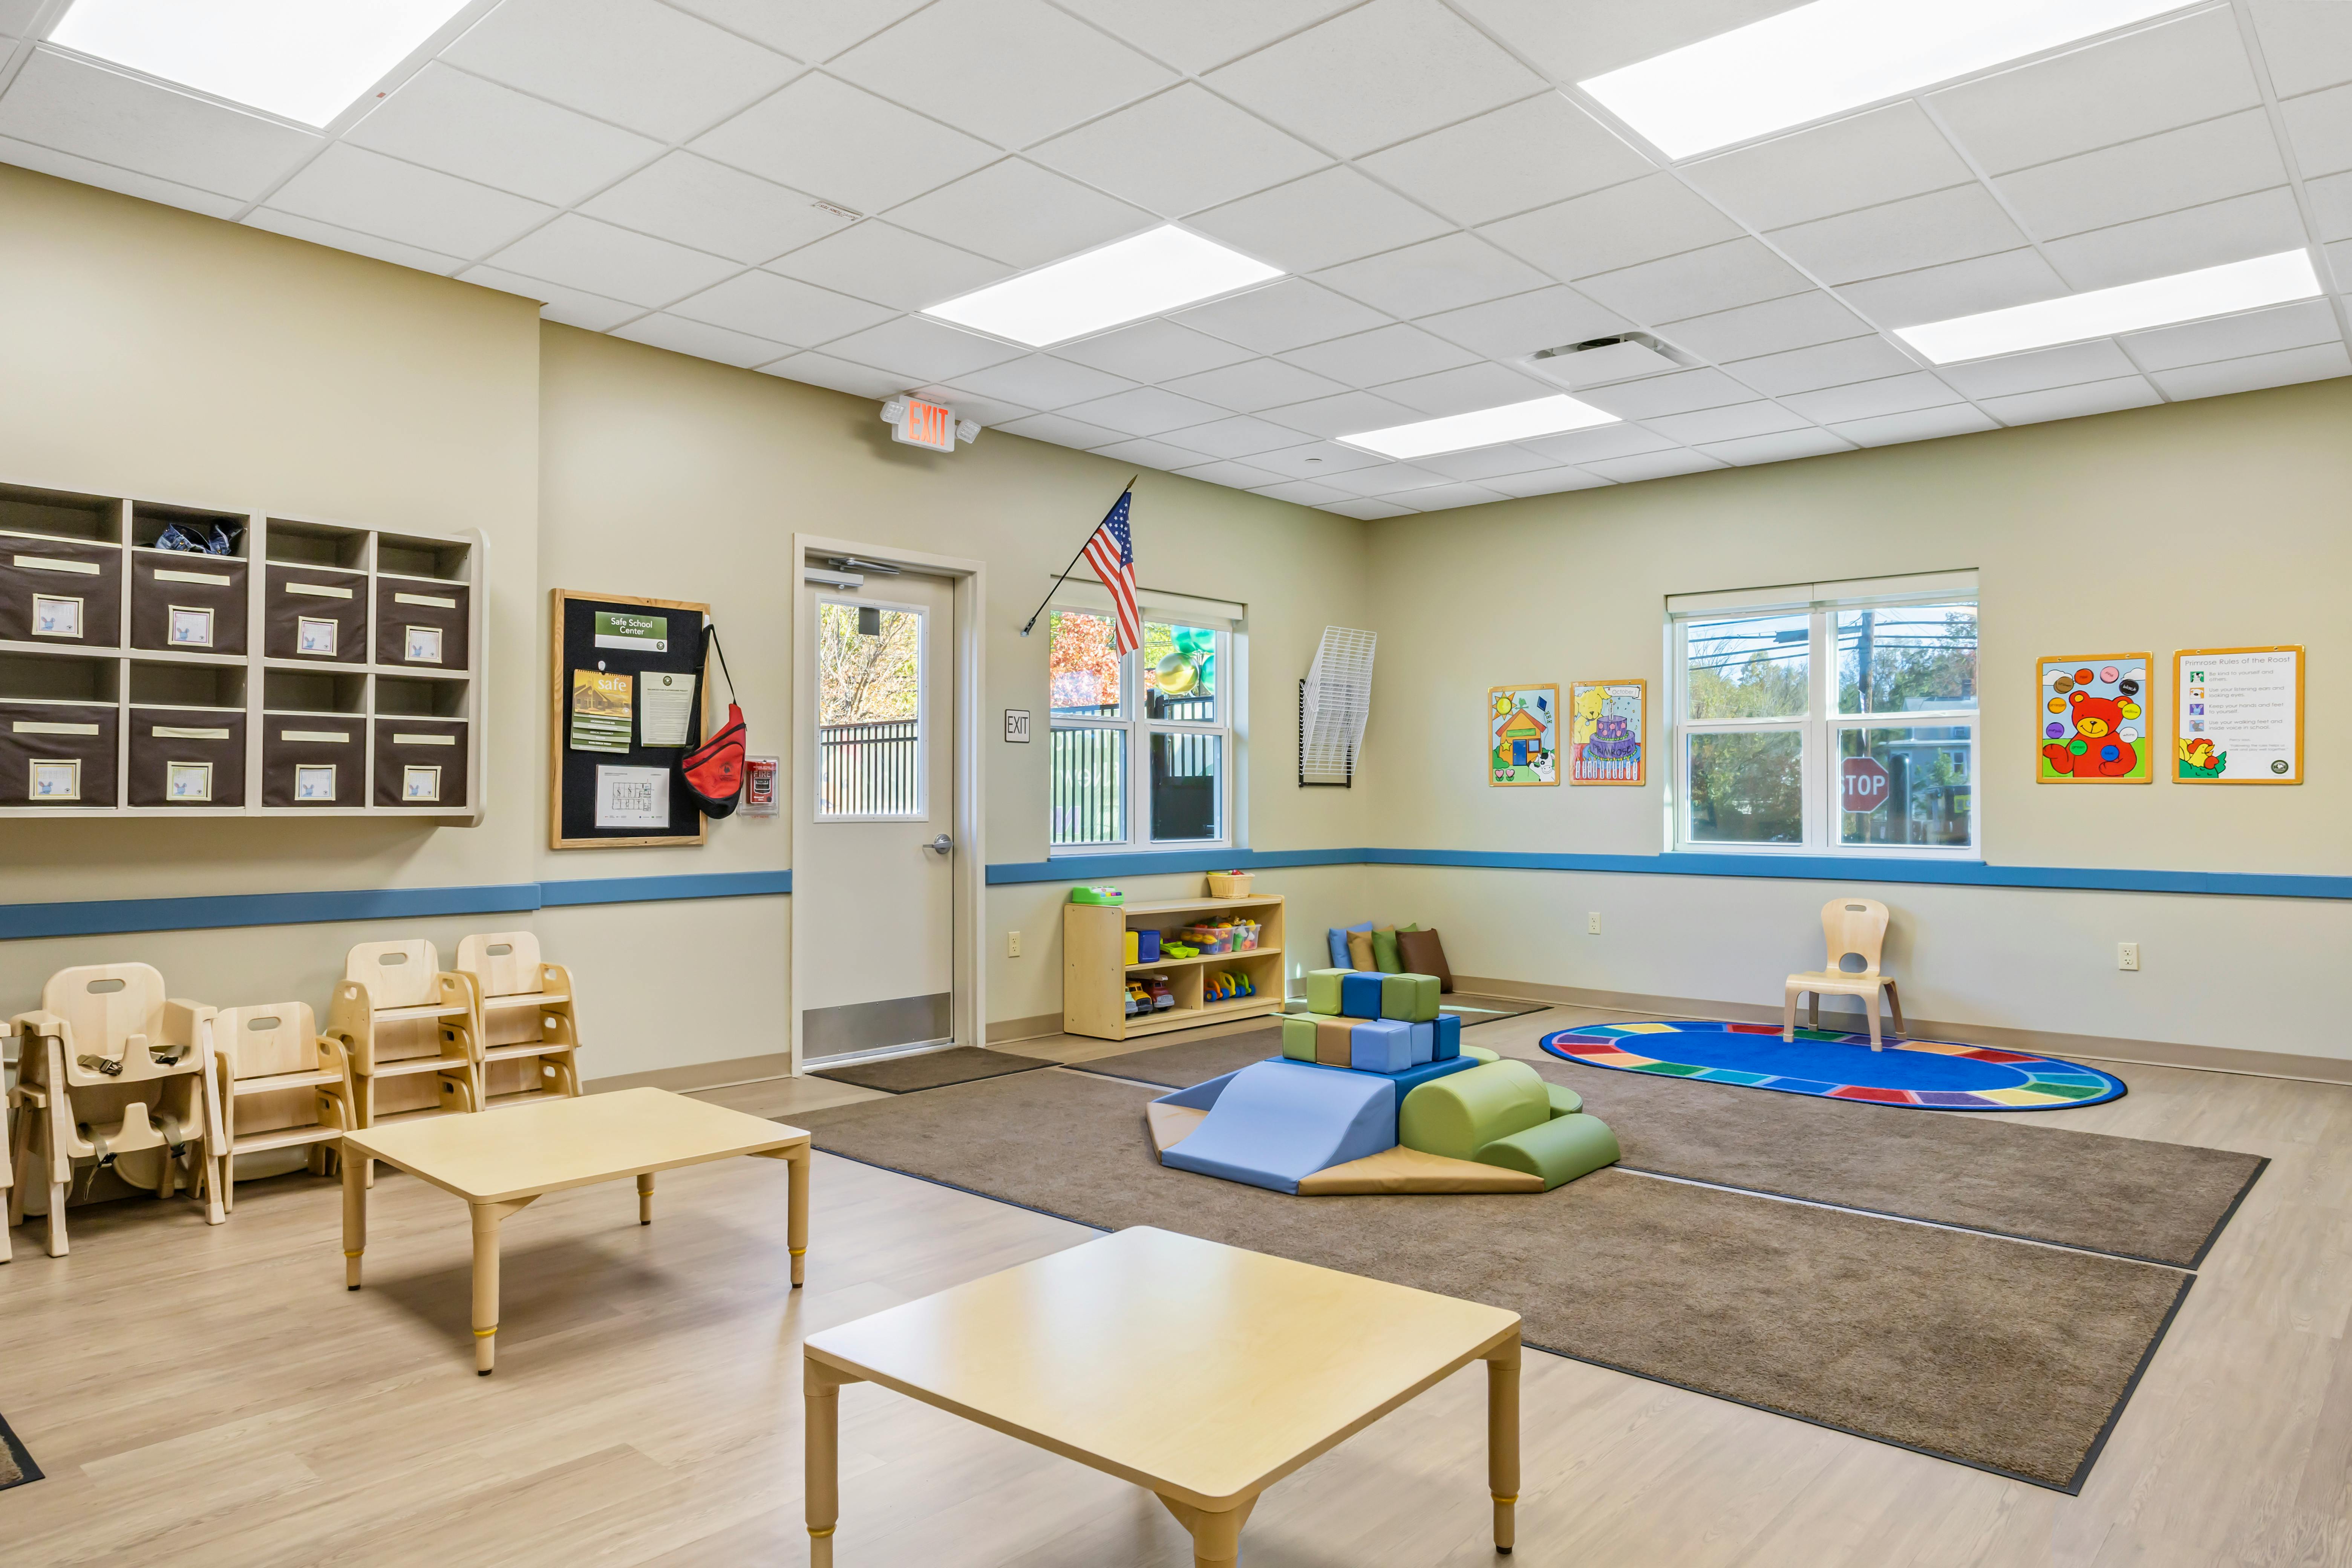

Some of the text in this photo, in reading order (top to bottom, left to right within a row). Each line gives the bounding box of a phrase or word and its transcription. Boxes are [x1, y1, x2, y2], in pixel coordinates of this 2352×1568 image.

[909, 401, 948, 446] EXIT
[611, 617, 653, 628] Safe School
[619, 626, 644, 635] Center
[598, 677, 627, 692] safe
[1008, 715, 1029, 735] EXIT
[1592, 743, 1631, 756] PRIMROSE
